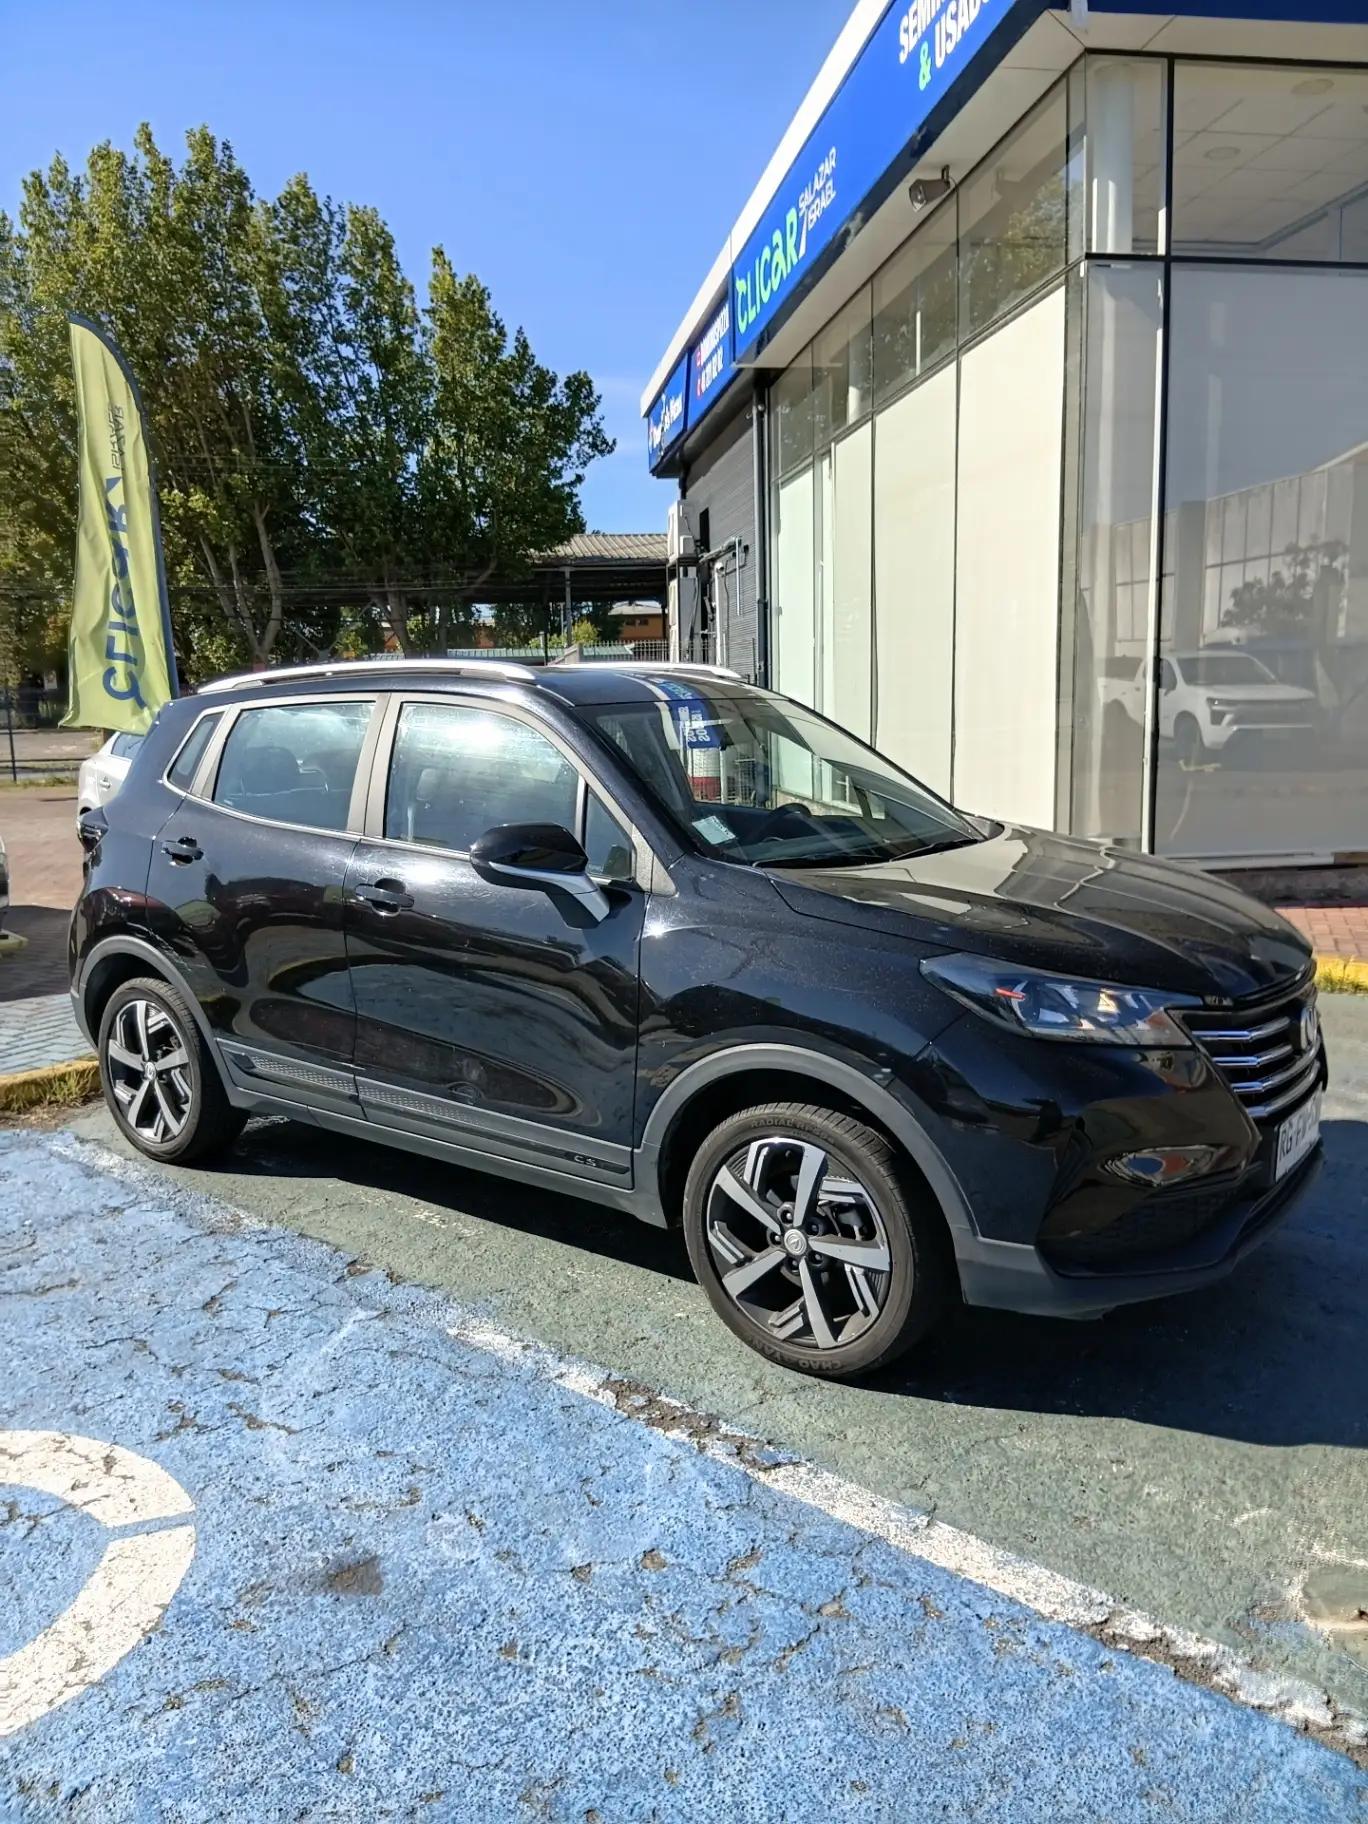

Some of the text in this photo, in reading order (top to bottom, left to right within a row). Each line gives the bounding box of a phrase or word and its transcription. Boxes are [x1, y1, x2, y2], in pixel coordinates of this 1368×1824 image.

[919, 0, 989, 91] & USAD
[799, 146, 837, 218] SALAZAR
[807, 179, 837, 231] ISRAEL
